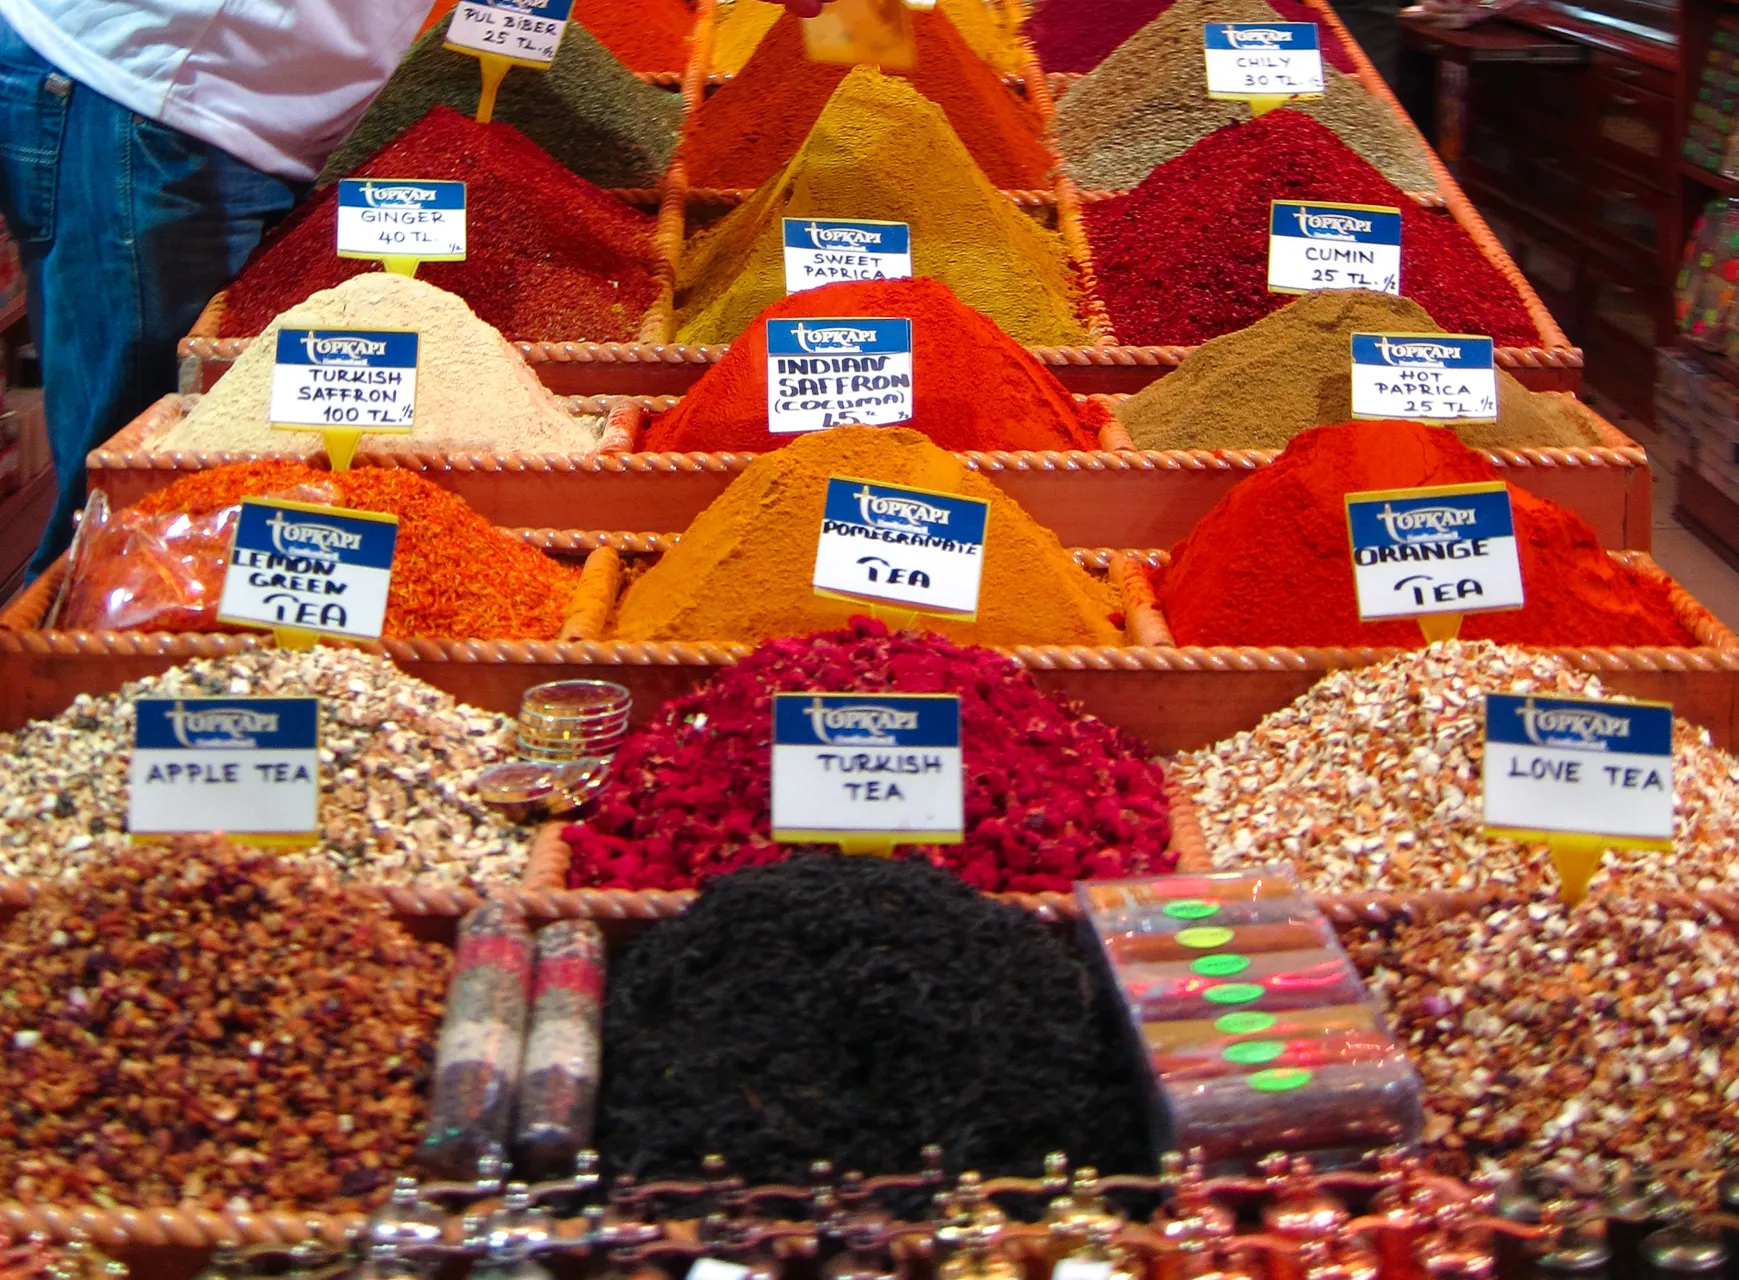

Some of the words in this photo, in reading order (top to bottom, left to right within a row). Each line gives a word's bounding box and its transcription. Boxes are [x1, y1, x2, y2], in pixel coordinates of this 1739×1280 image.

[463, 8, 496, 24] PUL
[482, 30, 510, 45] 25
[1236, 57, 1291, 69] CHILY
[1244, 74, 1269, 87] 30
[360, 209, 445, 225] GINGER
[378, 231, 405, 245] 40
[812, 253, 883, 268] SWEET
[1305, 246, 1375, 264] CUMIN
[803, 266, 886, 280] PAPRICA
[1311, 269, 1340, 282] 25
[777, 355, 891, 375] INDIAN
[309, 369, 402, 385] TURKISH
[1399, 370, 1443, 382] HOT
[778, 373, 910, 397] SAFFRON
[1374, 382, 1471, 396] PAPRICA
[297, 386, 397, 403] SAFFRON
[323, 406, 359, 422] 100
[1404, 400, 1434, 412] 25
[823, 520, 977, 555] POMEGRANATE
[1354, 538, 1490, 566] ORANGE
[232, 550, 337, 576] LEMON
[856, 556, 930, 588] TEA
[249, 573, 348, 595] GREEN
[1394, 574, 1484, 606] TEA
[262, 593, 347, 628] TEA
[817, 753, 942, 774] TURKISH
[146, 763, 240, 784] APPLE
[254, 763, 312, 784] TEA
[1508, 756, 1582, 784] LOVE
[1603, 765, 1665, 791] TEA
[843, 781, 905, 801] TEA
